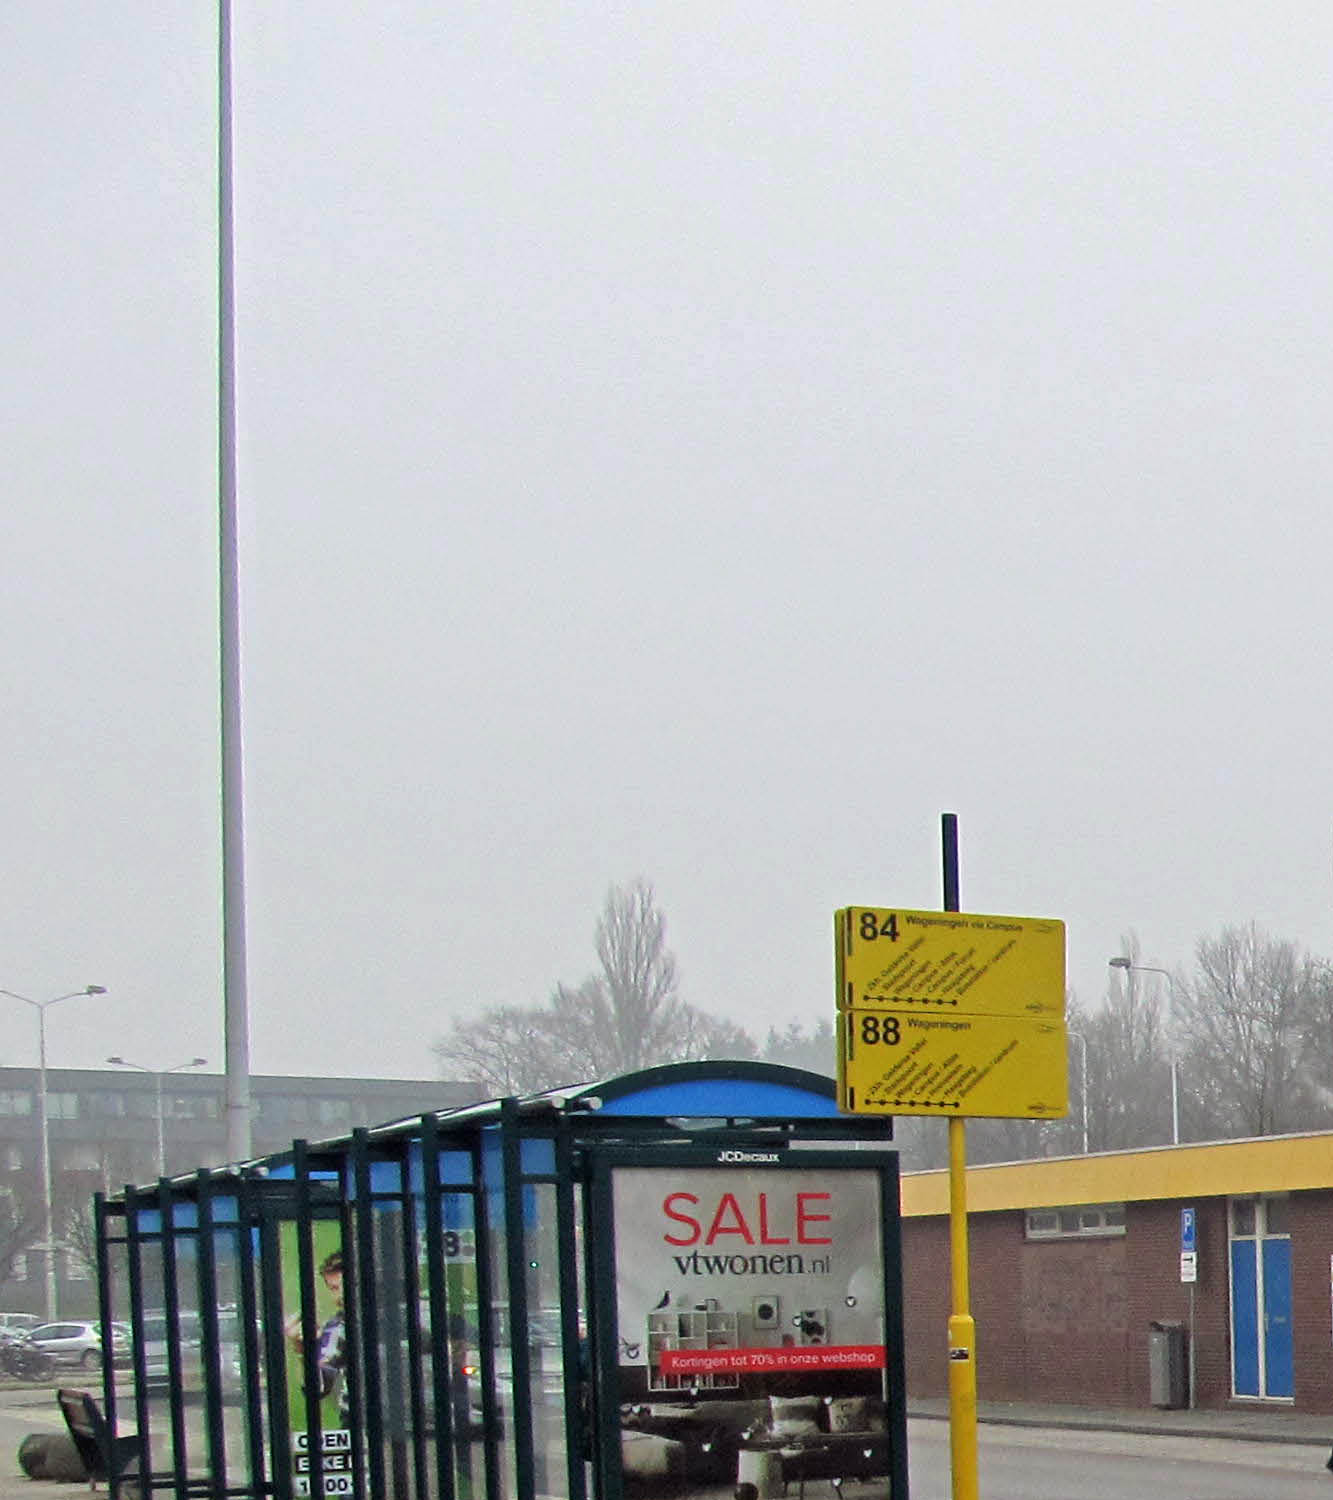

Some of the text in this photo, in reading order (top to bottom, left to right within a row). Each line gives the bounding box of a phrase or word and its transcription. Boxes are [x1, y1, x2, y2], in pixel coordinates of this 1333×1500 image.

[860, 912, 899, 942] 84
[861, 1015, 971, 1046] 88 Wageningen
[717, 1151, 780, 1163] JCDecaux
[662, 1192, 833, 1246] SALE
[673, 1250, 831, 1276] vtwonen.nl
[671, 1357, 727, 1369] Kortingen
[730, 1356, 748, 1366] tot
[777, 1355, 788, 1364] in
[792, 1354, 819, 1364] onze
[822, 1352, 876, 1364] webshop
